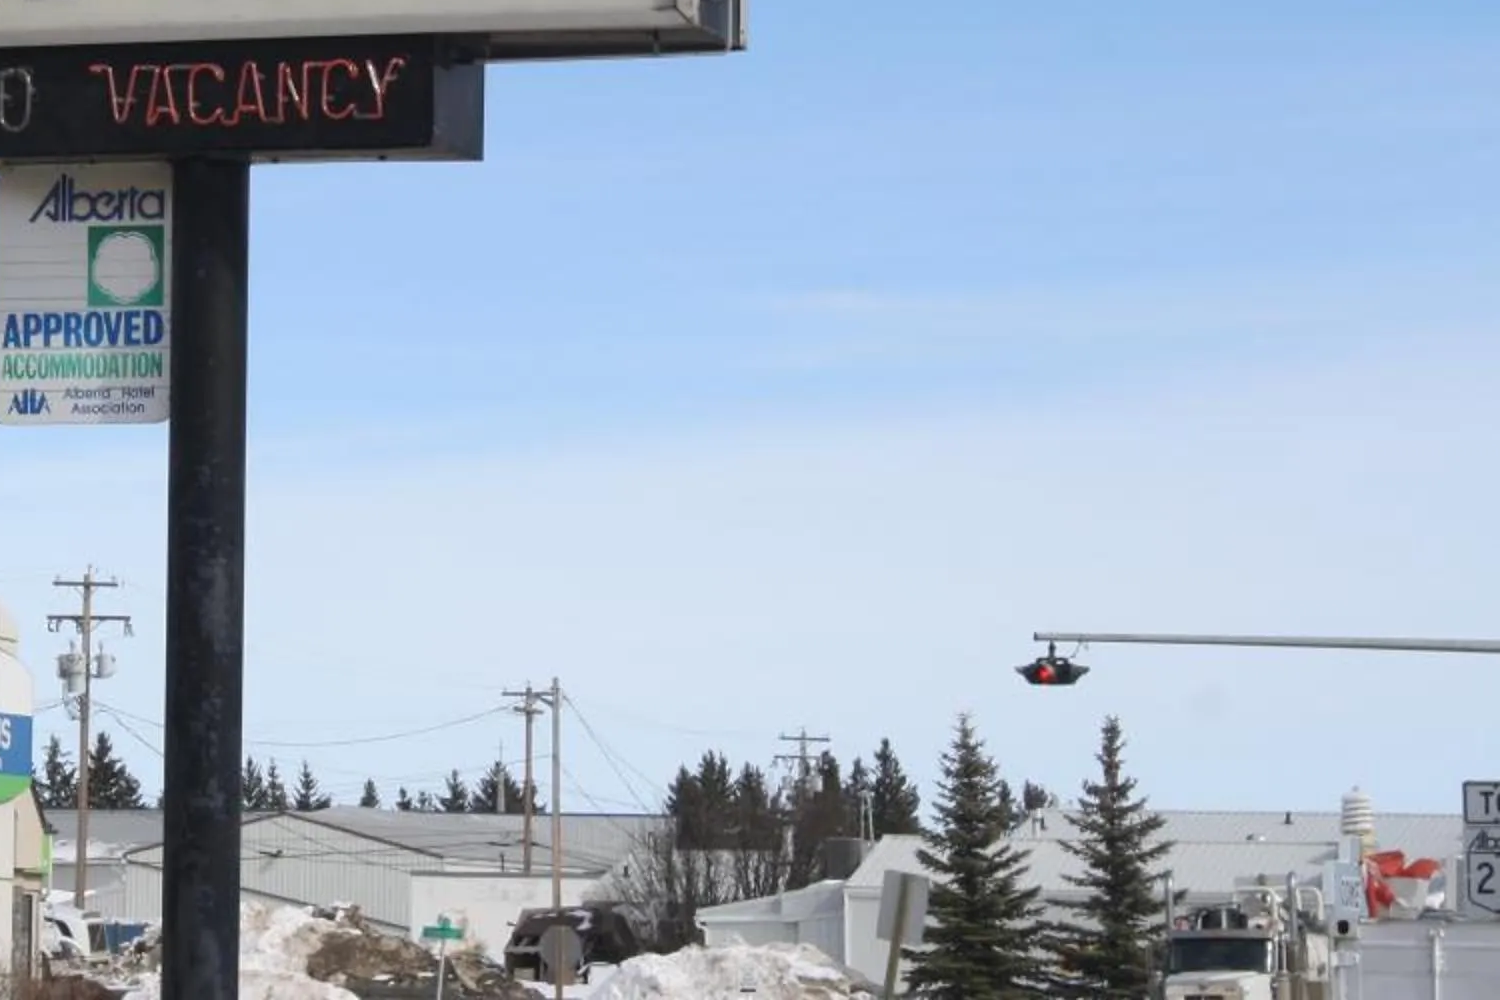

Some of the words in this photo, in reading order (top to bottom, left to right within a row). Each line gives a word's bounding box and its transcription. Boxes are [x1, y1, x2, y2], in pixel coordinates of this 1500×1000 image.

[89, 57, 405, 127] VACANCY
[28, 172, 165, 223] Alberta
[2, 309, 165, 349] APPROVED
[1, 351, 164, 380] ACCOMMODATION
[121, 385, 156, 399] Hotel
[70, 401, 146, 415] Association
[1479, 790, 1500, 816] T
